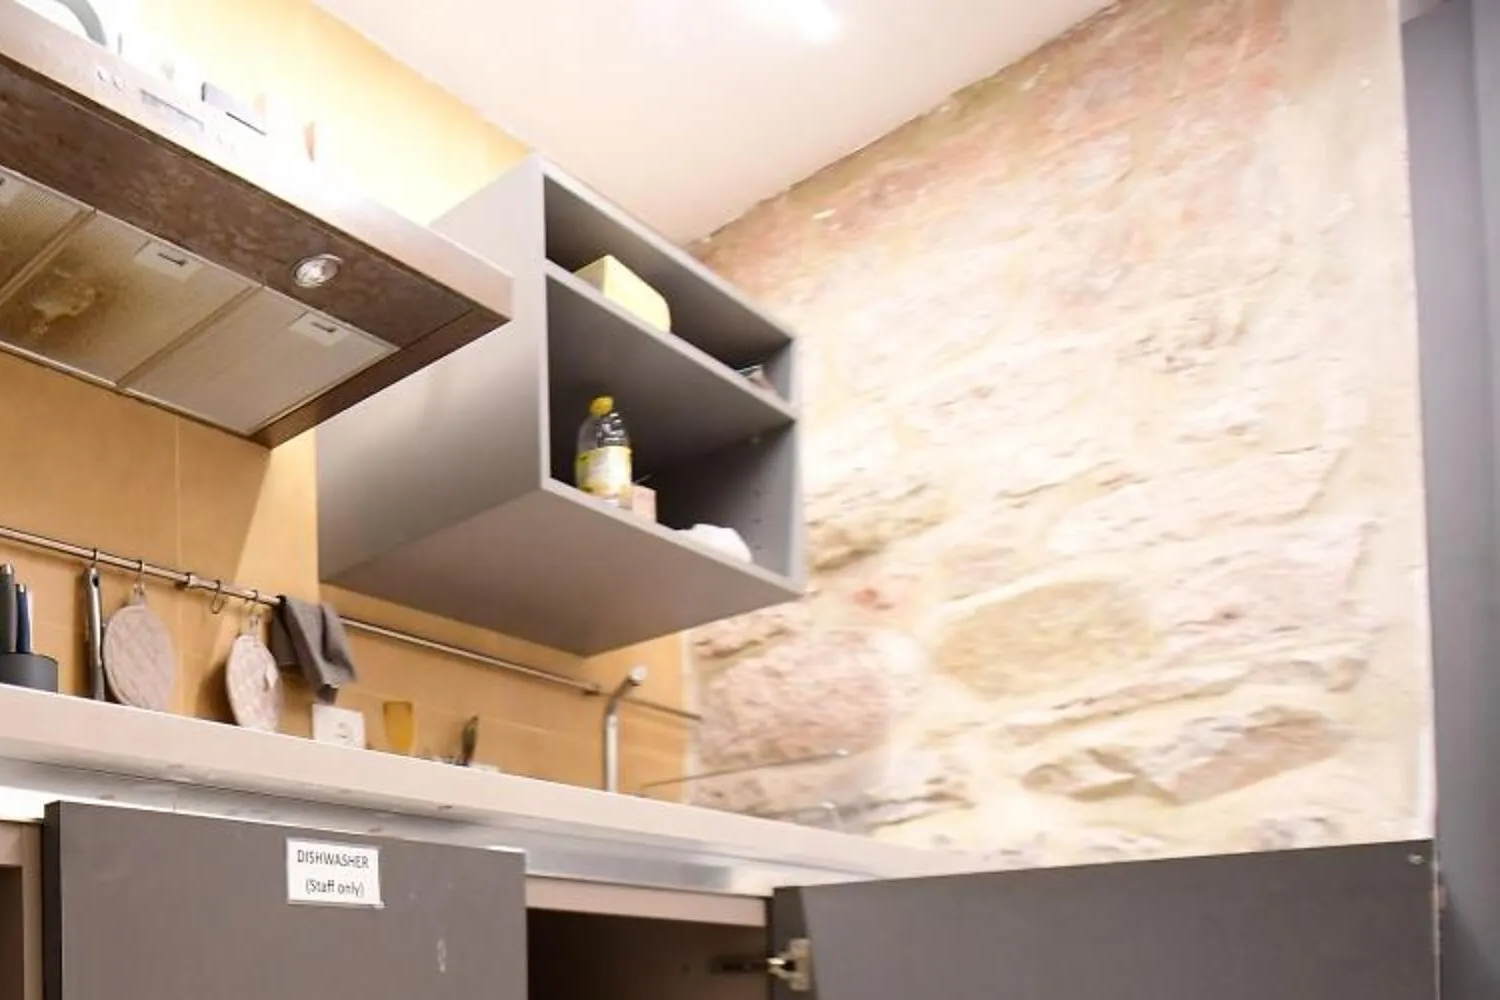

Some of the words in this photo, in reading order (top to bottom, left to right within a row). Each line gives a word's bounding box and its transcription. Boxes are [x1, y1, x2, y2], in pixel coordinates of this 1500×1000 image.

[297, 850, 370, 869] DISHWASHER
[306, 879, 335, 895] (Staff
[337, 881, 366, 898] only)
